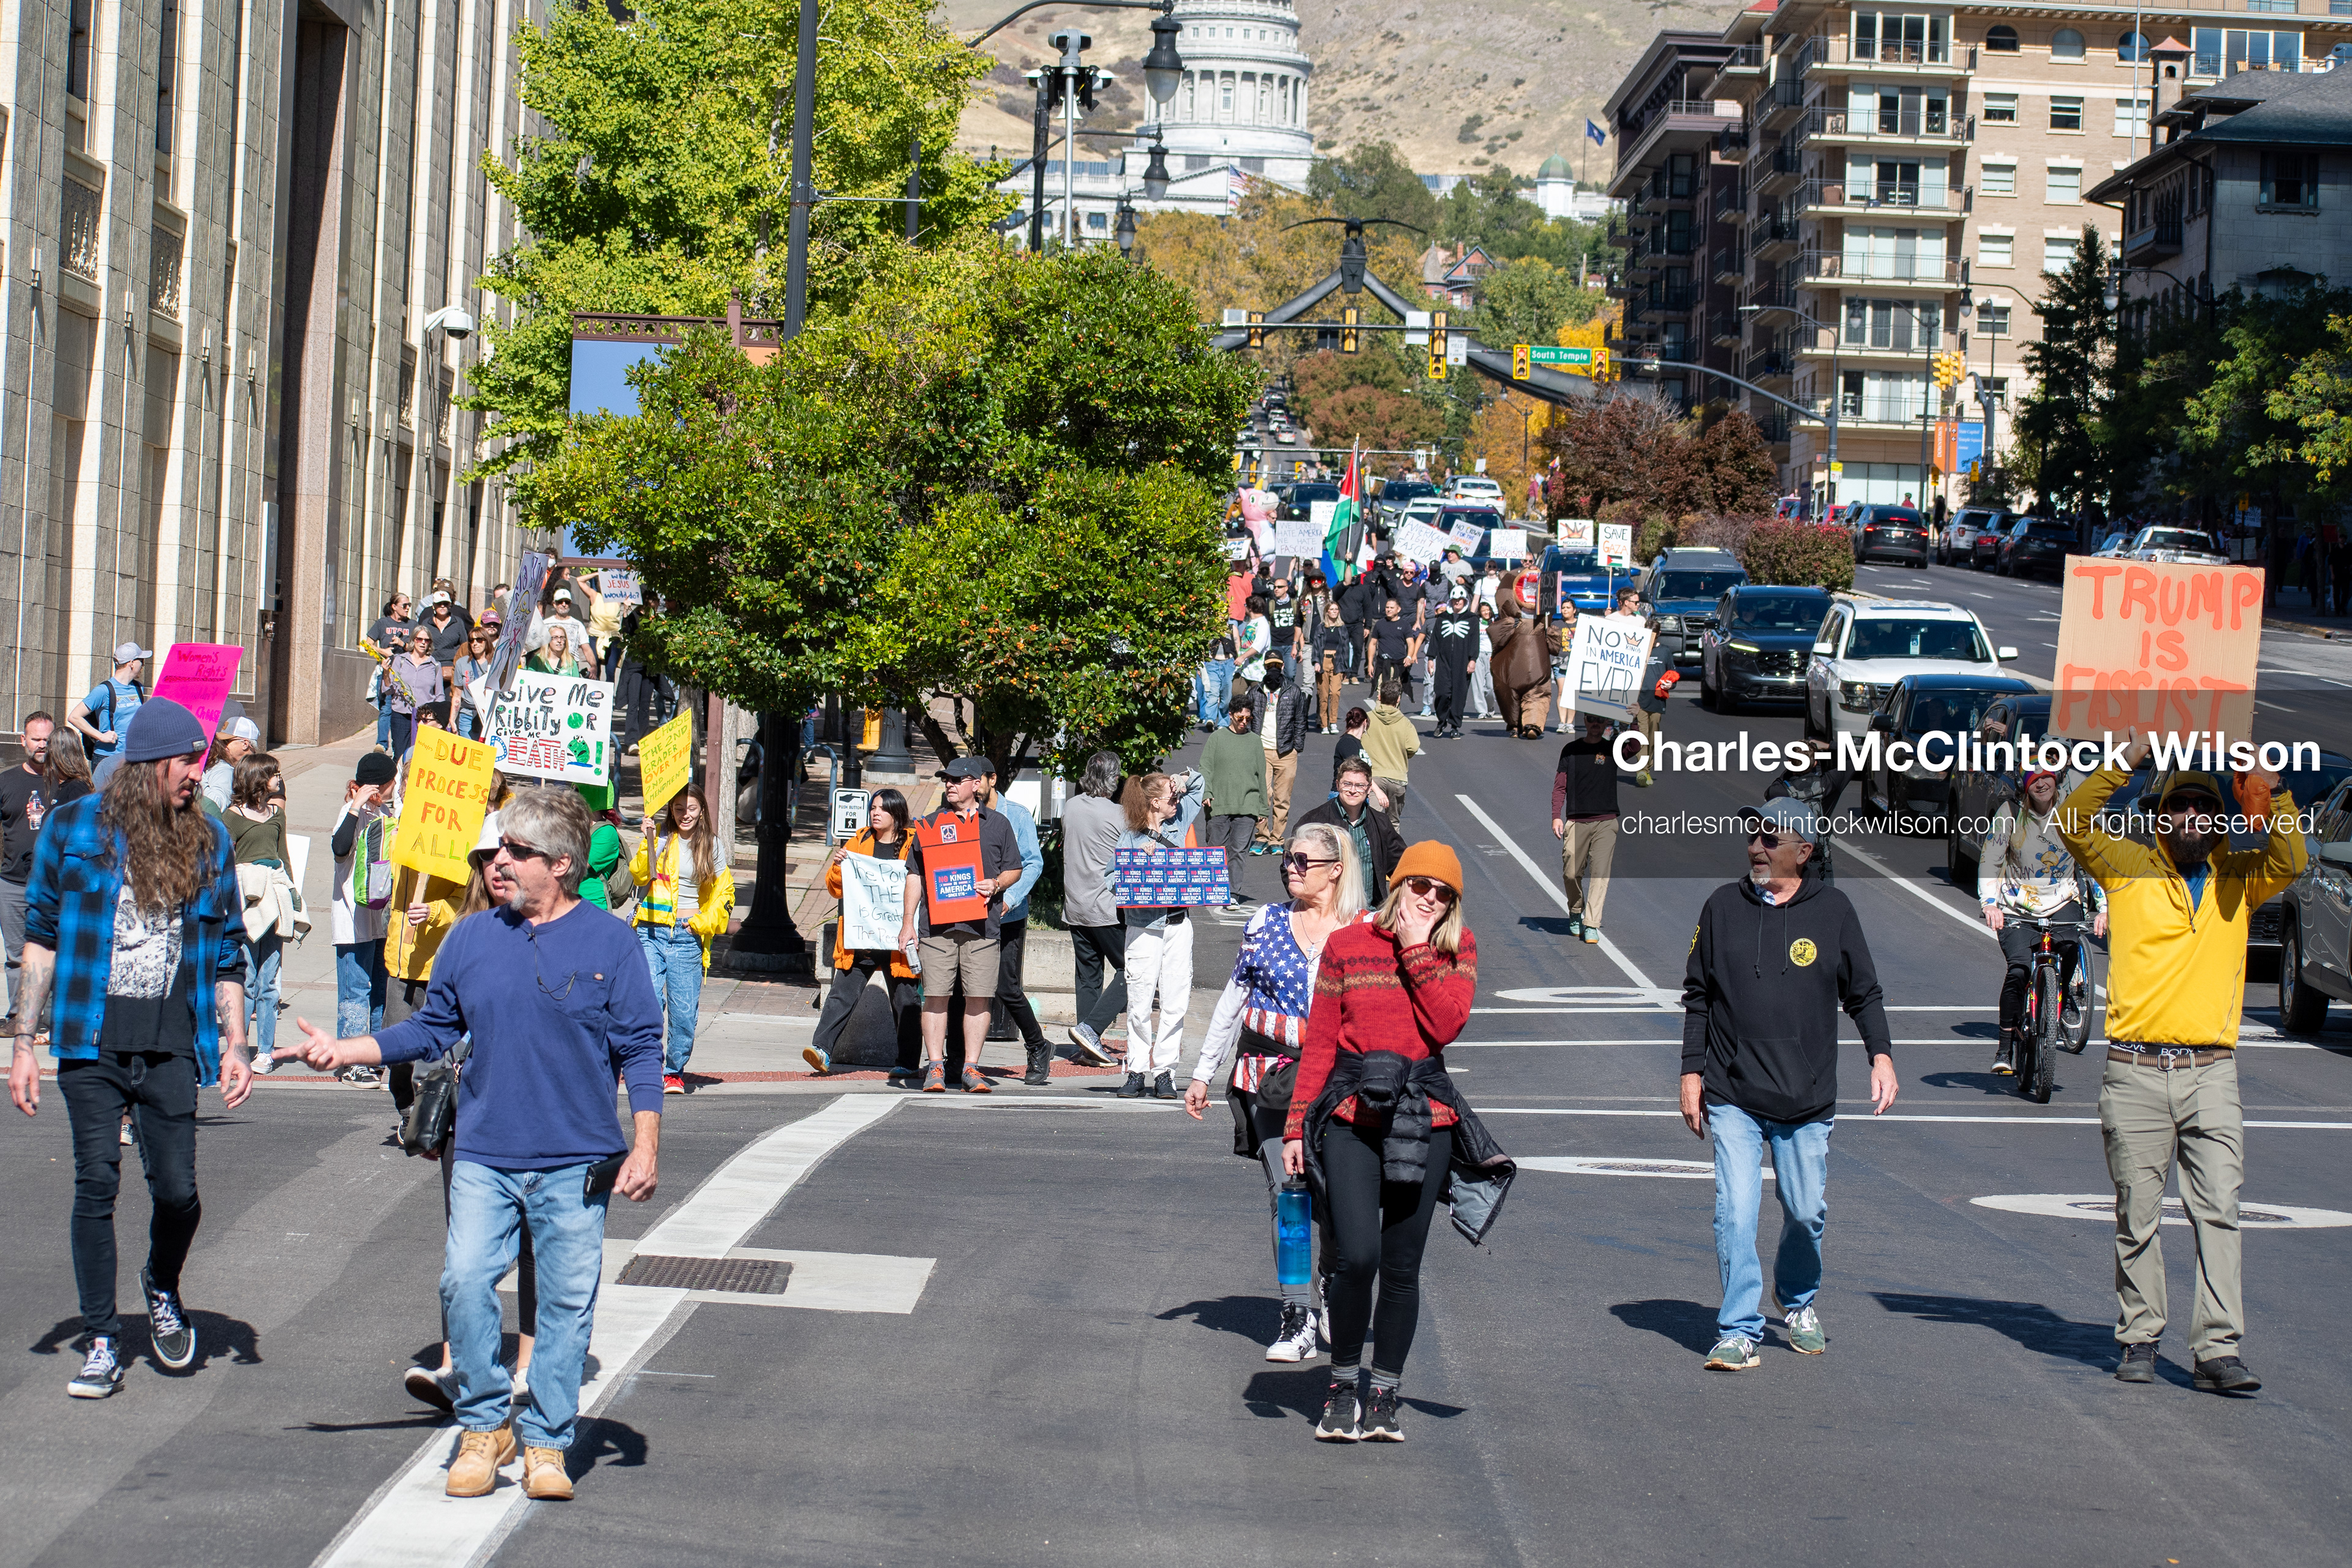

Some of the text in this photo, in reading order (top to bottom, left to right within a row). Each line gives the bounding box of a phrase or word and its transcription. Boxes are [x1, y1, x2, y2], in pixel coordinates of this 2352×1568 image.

[1532, 351, 1587, 362] South Temple
[1277, 530, 1295, 539] HATE
[1404, 531, 1434, 547] FIGHT
[1450, 535, 1472, 546] ORANGE
[1466, 527, 1482, 537] CROWN
[1604, 526, 1628, 541] SAVE
[1395, 538, 1437, 560] FASCISM
[1603, 540, 1629, 556] GAZA
[607, 579, 630, 589] JESUS
[1540, 571, 1558, 589] RESIST
[2073, 565, 2261, 631] TRUMP
[385, 627, 410, 636] UTAH
[1274, 617, 1294, 628] ICE
[1587, 625, 1621, 647] NO
[178, 650, 220, 664] Women's
[1586, 646, 1597, 657] IN
[1600, 649, 1640, 669] AMERICA
[1626, 644, 1641, 654] KINGS
[2139, 630, 2189, 672] IS
[1579, 661, 1634, 704] EVER
[567, 684, 605, 708] Me
[2057, 663, 2248, 752] FASCIST
[567, 712, 597, 731] OR
[641, 739, 649, 750] I
[655, 710, 690, 741] CHOOSE
[496, 727, 521, 736] Give
[642, 743, 663, 761] THE
[665, 725, 688, 747] 2ND
[434, 739, 483, 771] DUE
[491, 735, 565, 772] DEATH
[644, 744, 677, 774] GRADER
[644, 742, 691, 784] OVER THE
[415, 767, 489, 805] PROCESS
[644, 764, 688, 808] AMENDMENT
[645, 777, 664, 796] 2ND
[420, 801, 462, 832] FOR
[410, 832, 470, 864] ALL!
[848, 858, 876, 881] The
[950, 873, 971, 881] KINGS
[863, 885, 903, 903] THE
[940, 884, 972, 894] AMERICA
[859, 905, 903, 922] Is Greate
[853, 925, 875, 940] The
